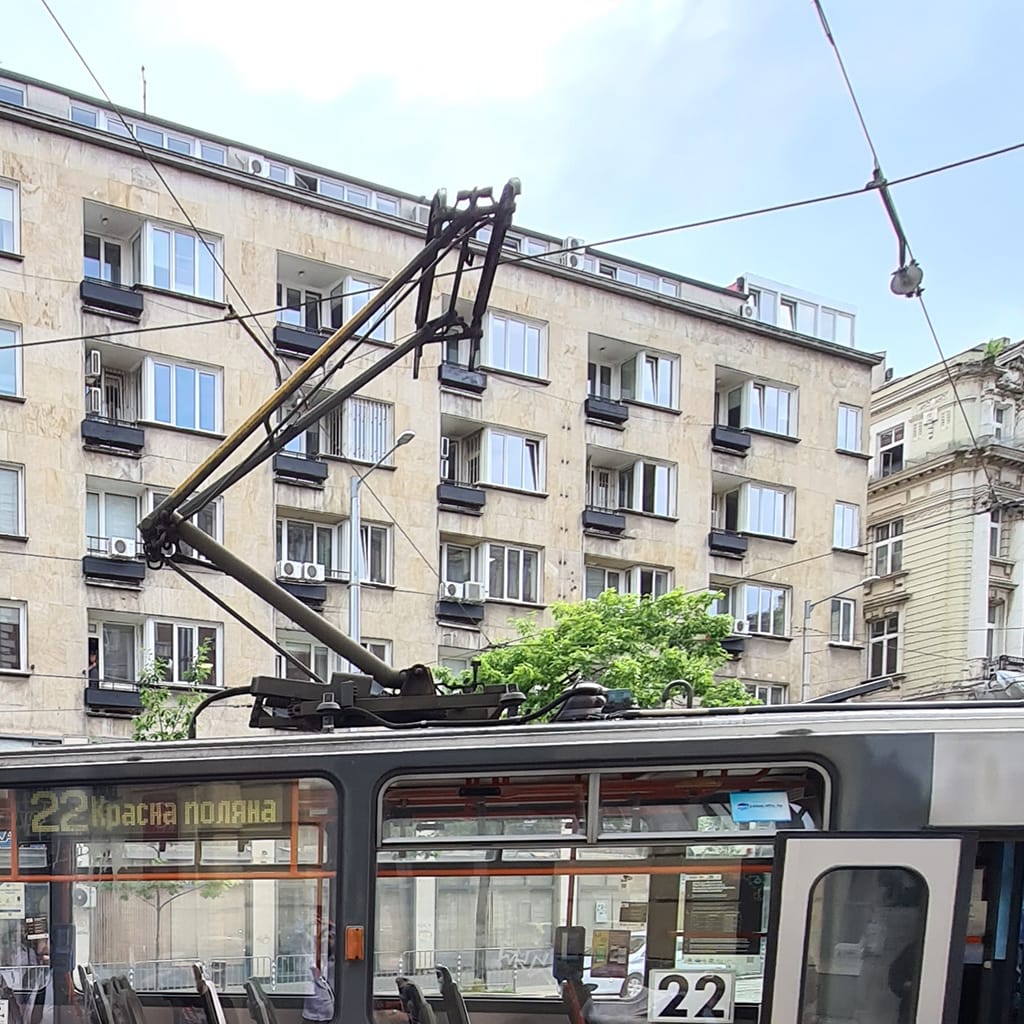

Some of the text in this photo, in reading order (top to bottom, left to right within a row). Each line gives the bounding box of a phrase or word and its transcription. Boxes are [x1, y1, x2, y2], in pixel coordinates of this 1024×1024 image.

[30, 790, 276, 833] 22 Красна поляна
[658, 974, 726, 1018] 22
